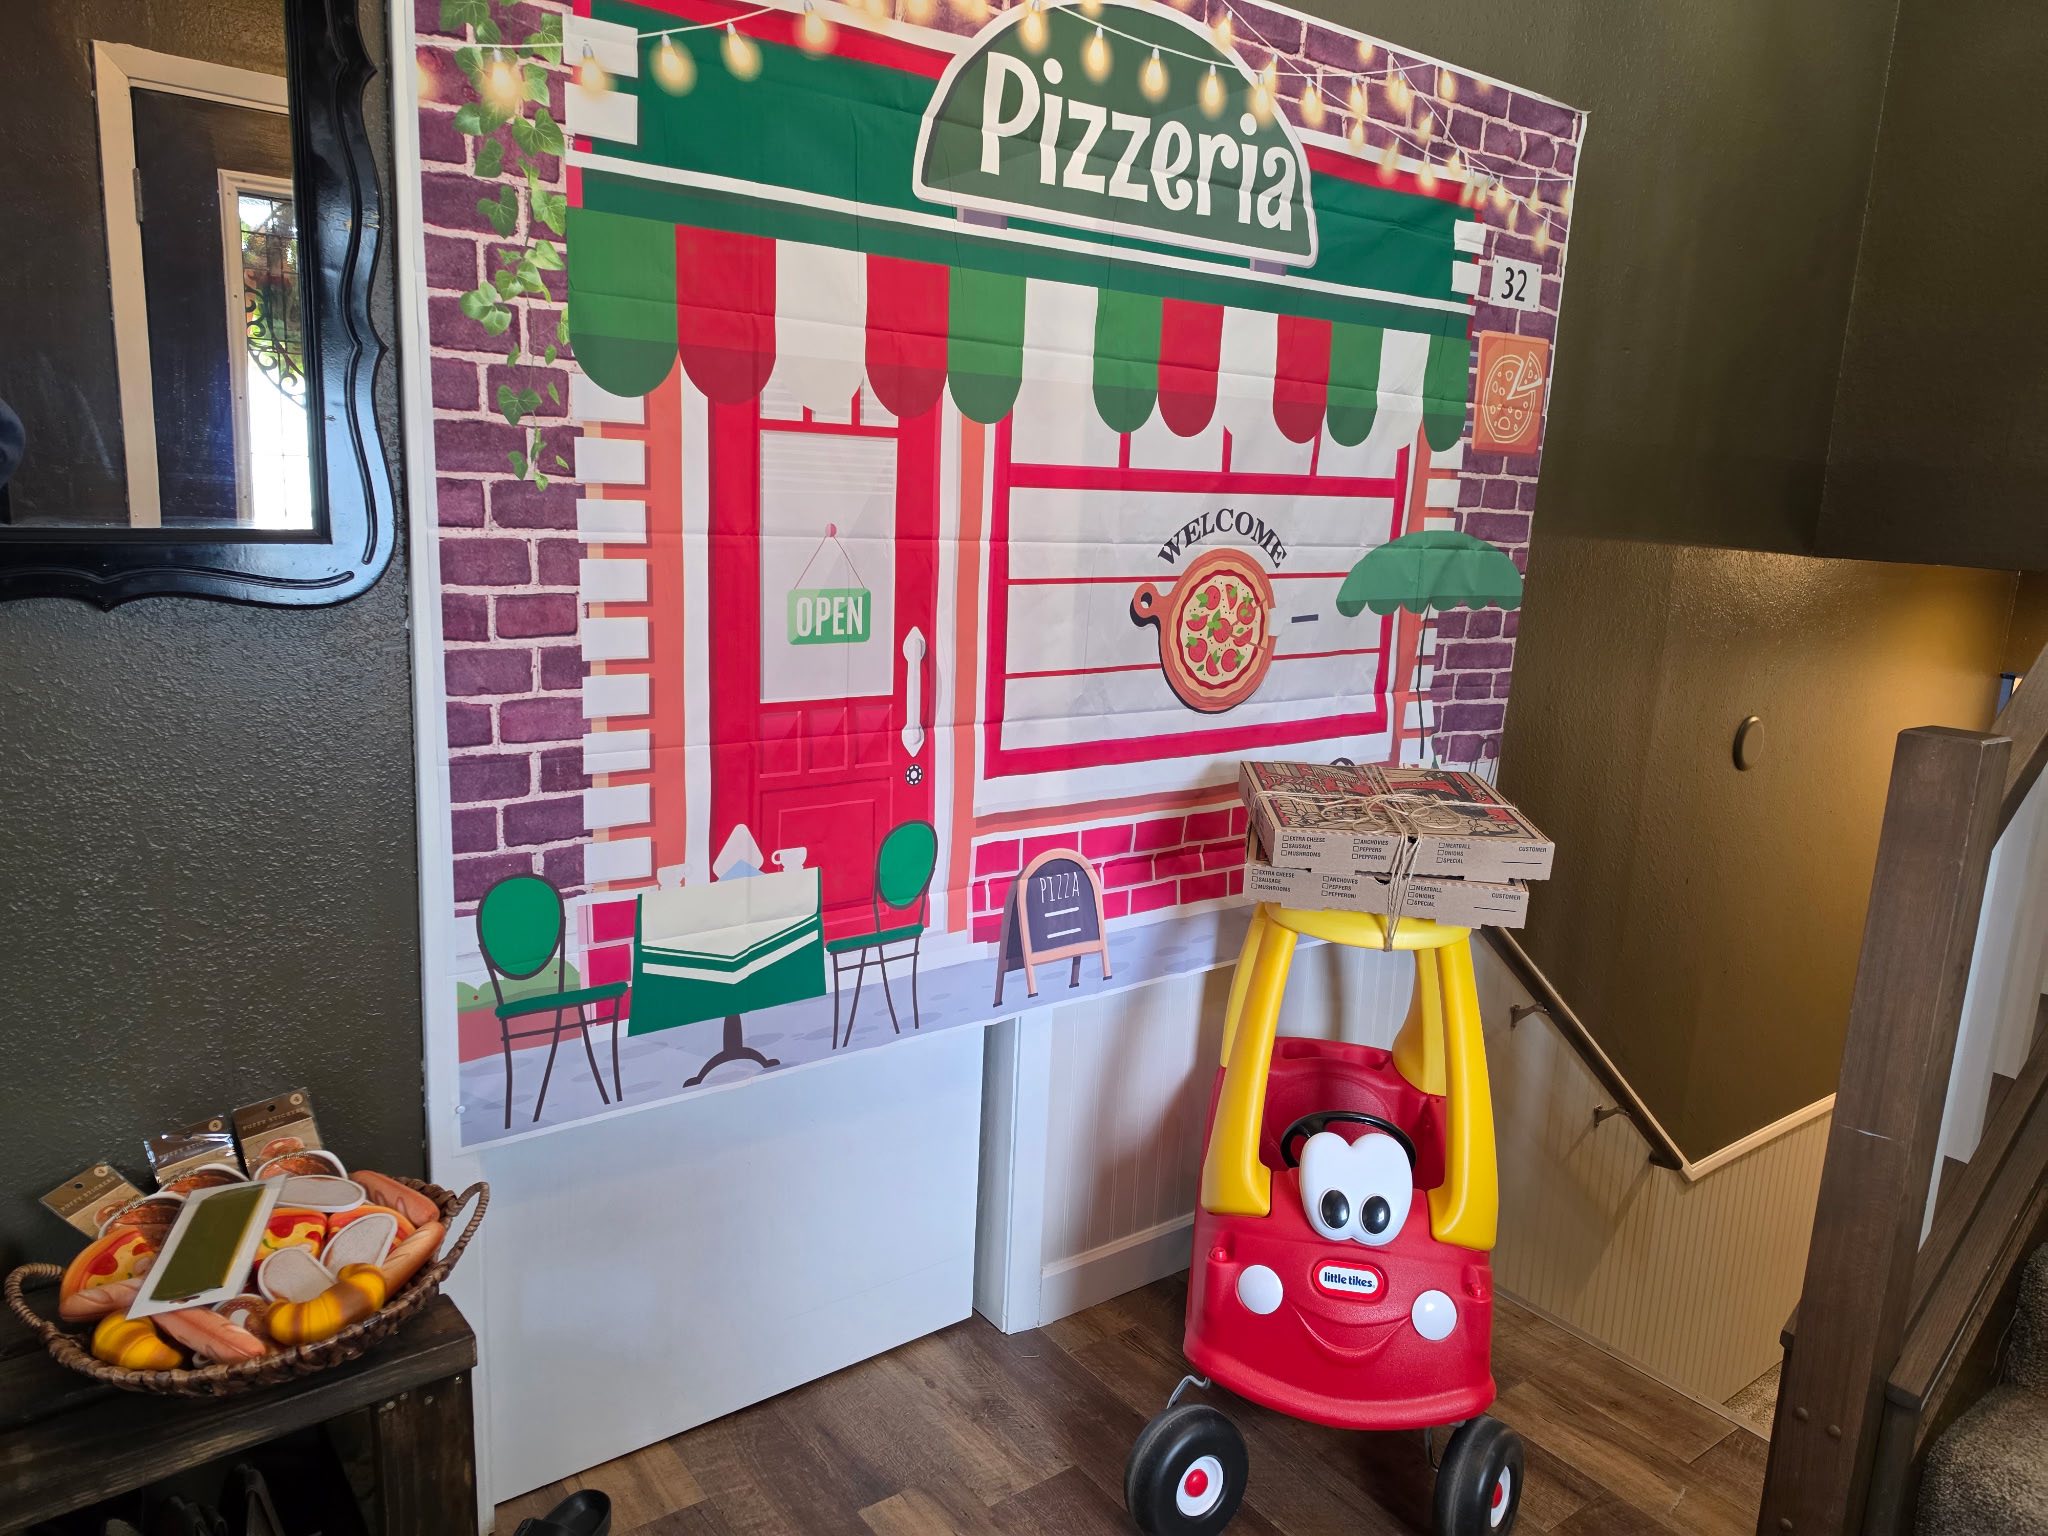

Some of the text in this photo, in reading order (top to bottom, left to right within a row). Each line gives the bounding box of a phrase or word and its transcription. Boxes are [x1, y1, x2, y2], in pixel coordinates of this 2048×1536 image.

[980, 50, 1297, 233] Pizzeria
[1501, 266, 1527, 302] 32
[1157, 508, 1287, 568] WELCOME
[796, 596, 863, 637] OPEN
[1288, 850, 1321, 858] MUSHROOMS
[1259, 869, 1276, 877] EXTRA
[1039, 871, 1080, 903] PIZZA
[1258, 884, 1291, 892] MUSHROOMS
[1415, 885, 1442, 893] MEATBALL
[1329, 891, 1357, 899] PEPPERONI
[1491, 892, 1521, 901] CUSTOMER
[1324, 1271, 1373, 1288] little tikes
